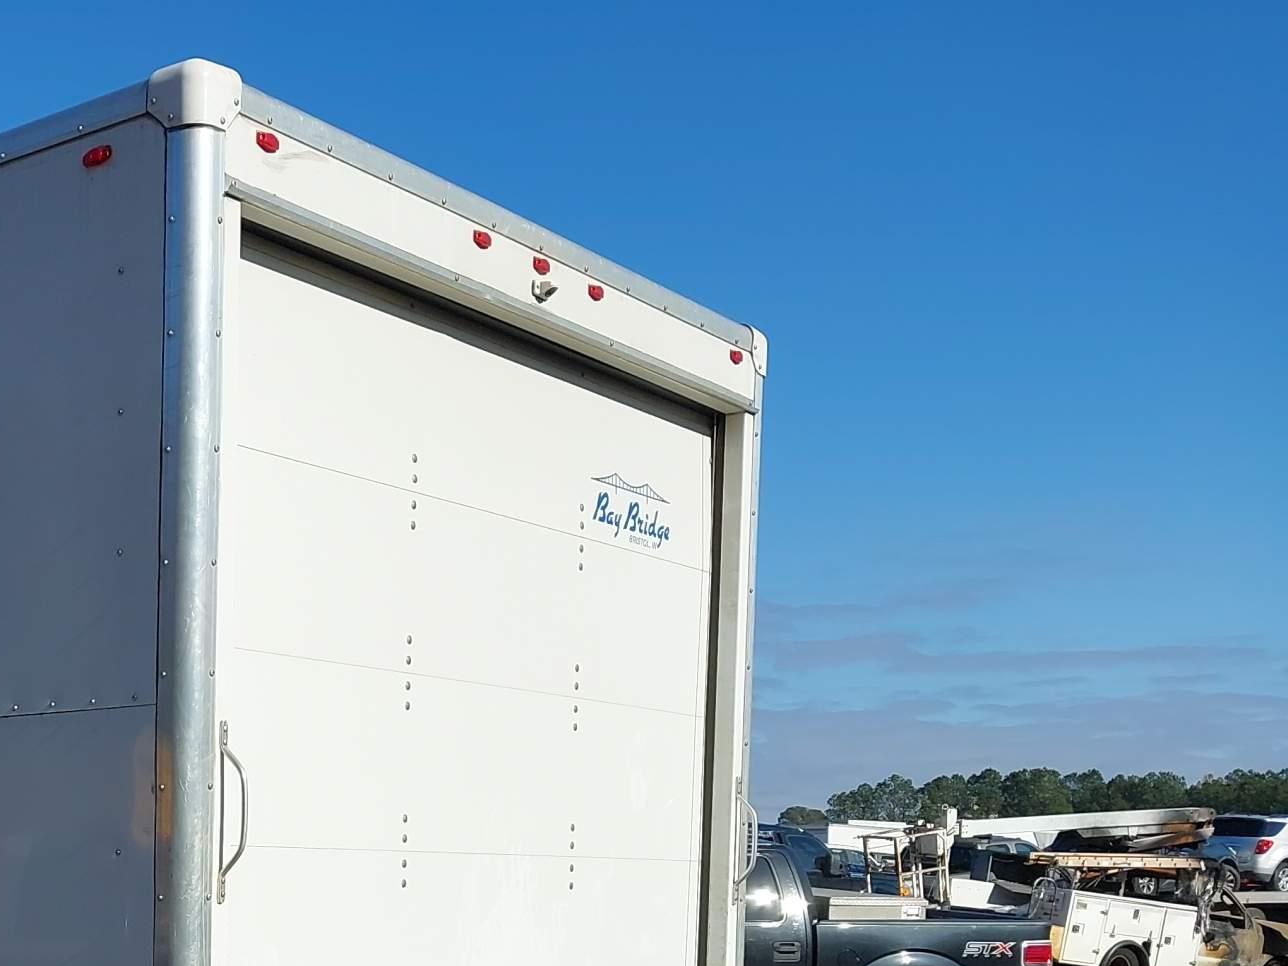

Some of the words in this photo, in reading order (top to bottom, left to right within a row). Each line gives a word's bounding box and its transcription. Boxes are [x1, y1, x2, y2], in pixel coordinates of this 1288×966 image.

[592, 491, 622, 538] Bay
[623, 501, 670, 549] Bridge
[963, 941, 1016, 955] STX
